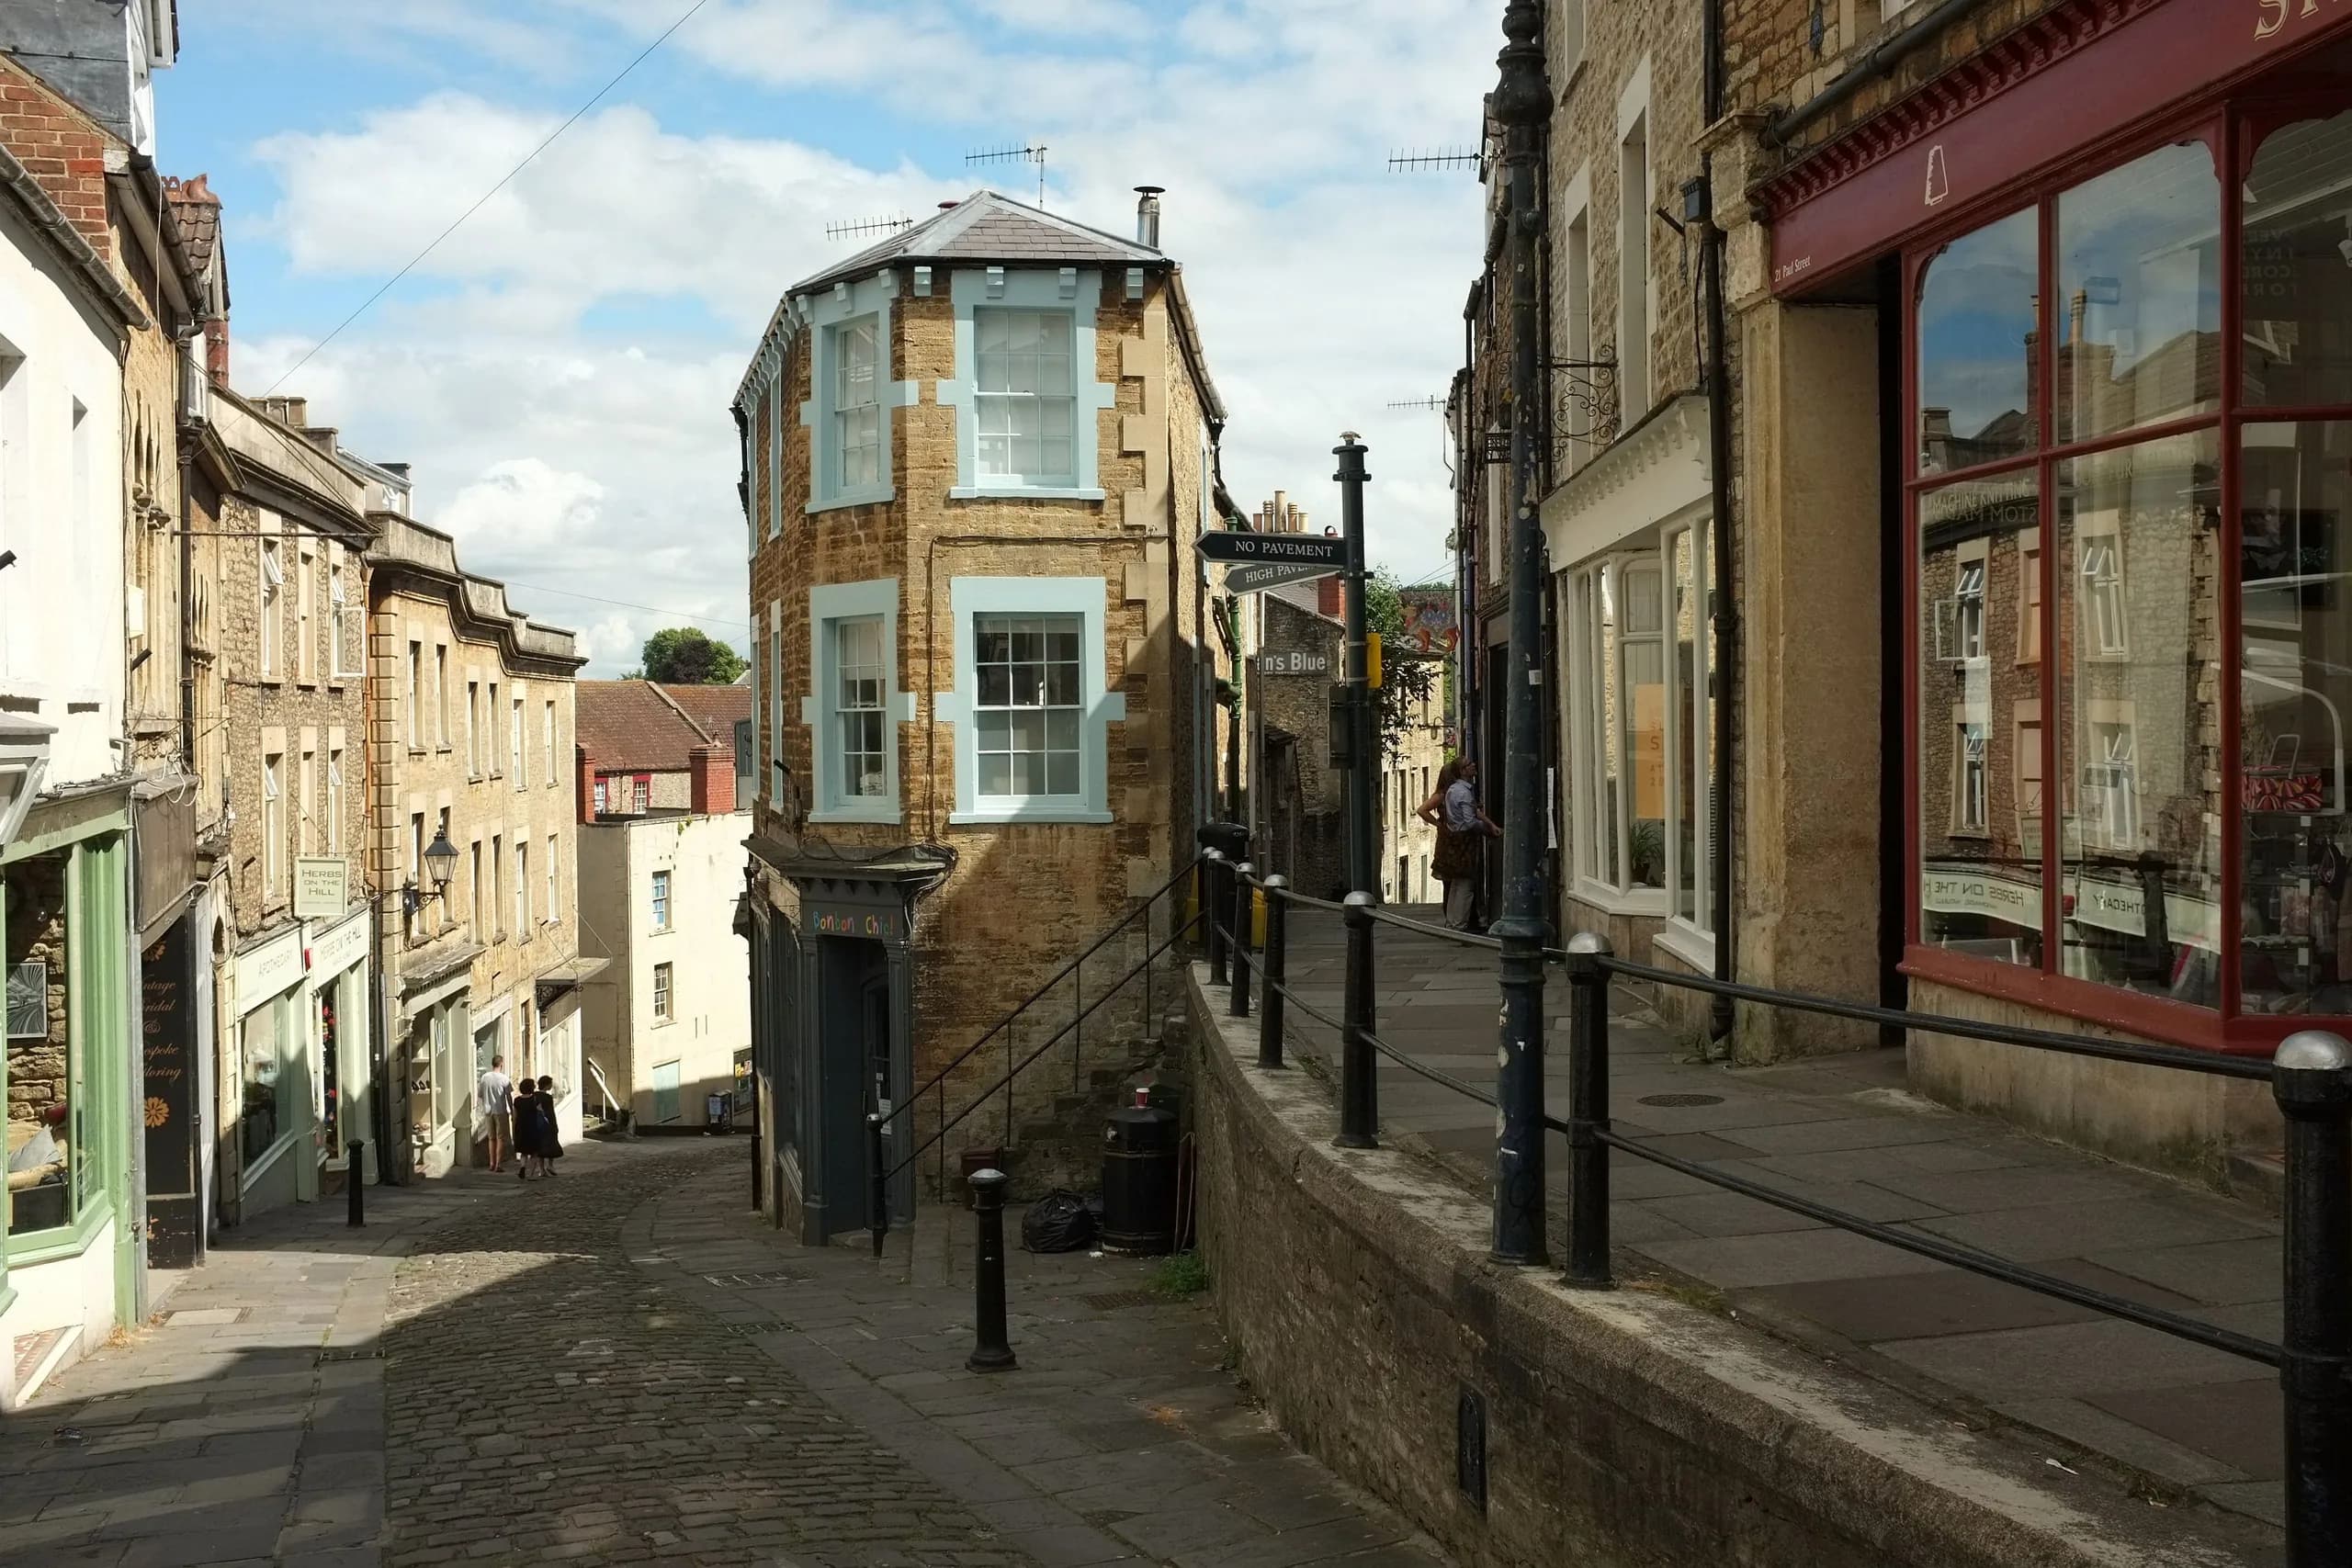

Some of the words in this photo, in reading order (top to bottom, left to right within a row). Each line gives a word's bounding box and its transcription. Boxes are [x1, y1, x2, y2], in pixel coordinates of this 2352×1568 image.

[1782, 261, 1794, 279] Paul
[1794, 254, 1811, 273] Street
[1235, 540, 1256, 553] NO
[1261, 542, 1334, 558] PAVEMENT
[1245, 568, 1273, 584] HIGH
[1257, 655, 1285, 671] n's
[1291, 652, 1326, 671] Blue
[301, 869, 343, 878] HERBS
[309, 887, 335, 897] HILL
[812, 910, 855, 934] Bonbon
[143, 999, 176, 1012] ridal
[143, 1042, 180, 1061] espoke
